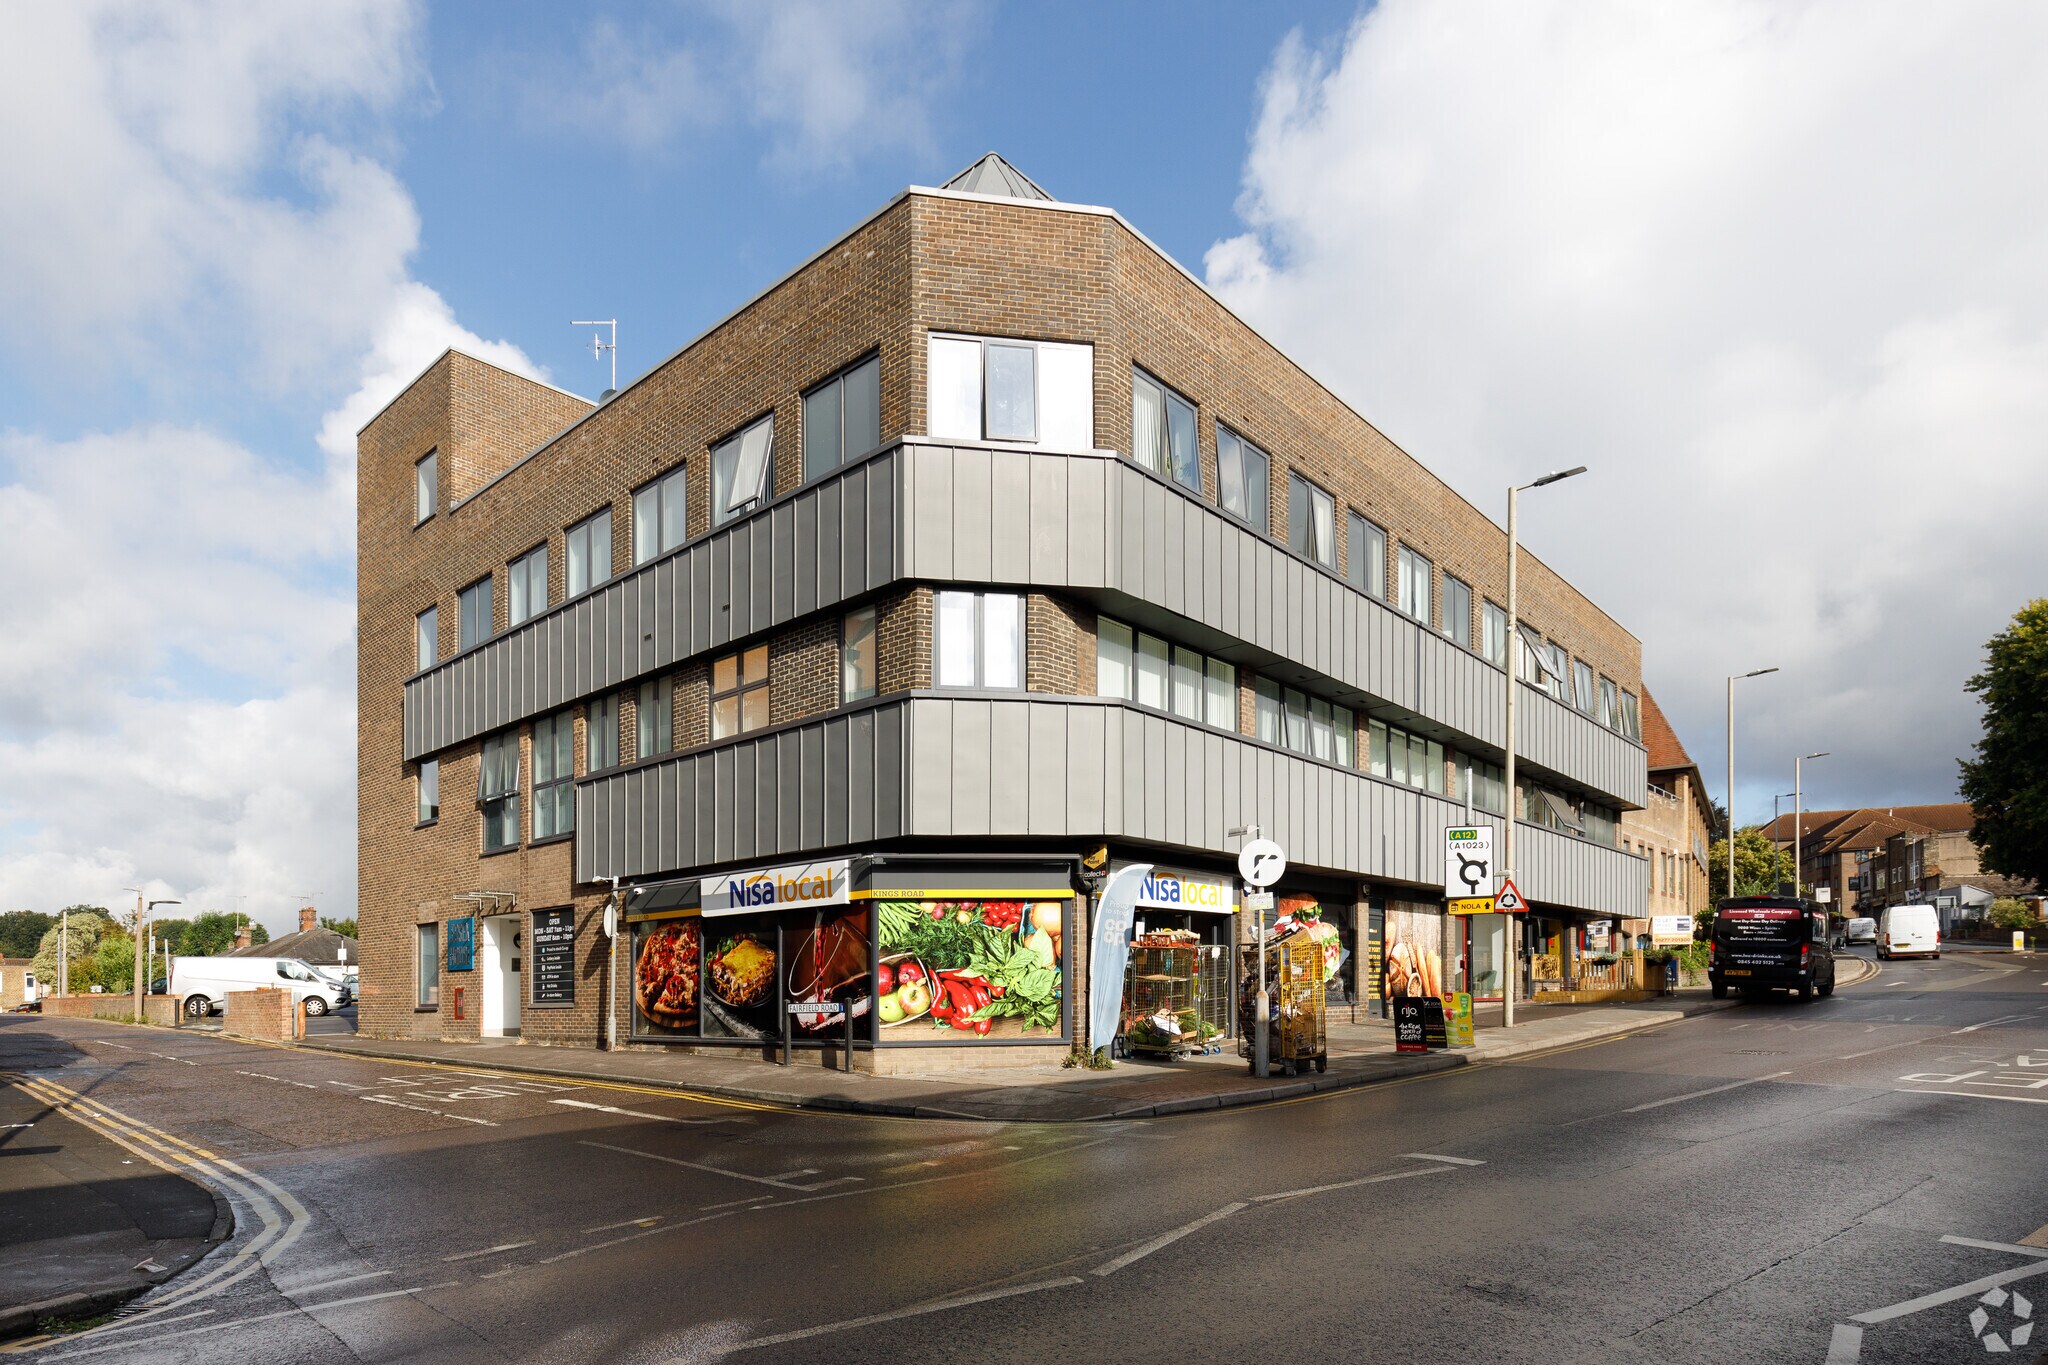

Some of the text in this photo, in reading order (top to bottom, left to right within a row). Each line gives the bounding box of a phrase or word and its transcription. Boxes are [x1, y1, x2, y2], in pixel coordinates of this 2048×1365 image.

[730, 867, 833, 909] Nisa local
[1140, 872, 1180, 903] Nisa
[1182, 875, 1223, 906] local
[873, 890, 925, 898] KINGS ROAD
[534, 927, 543, 935] MON
[546, 926, 554, 934] SAT
[789, 1004, 838, 1012] FAIRFIELD ROAD
